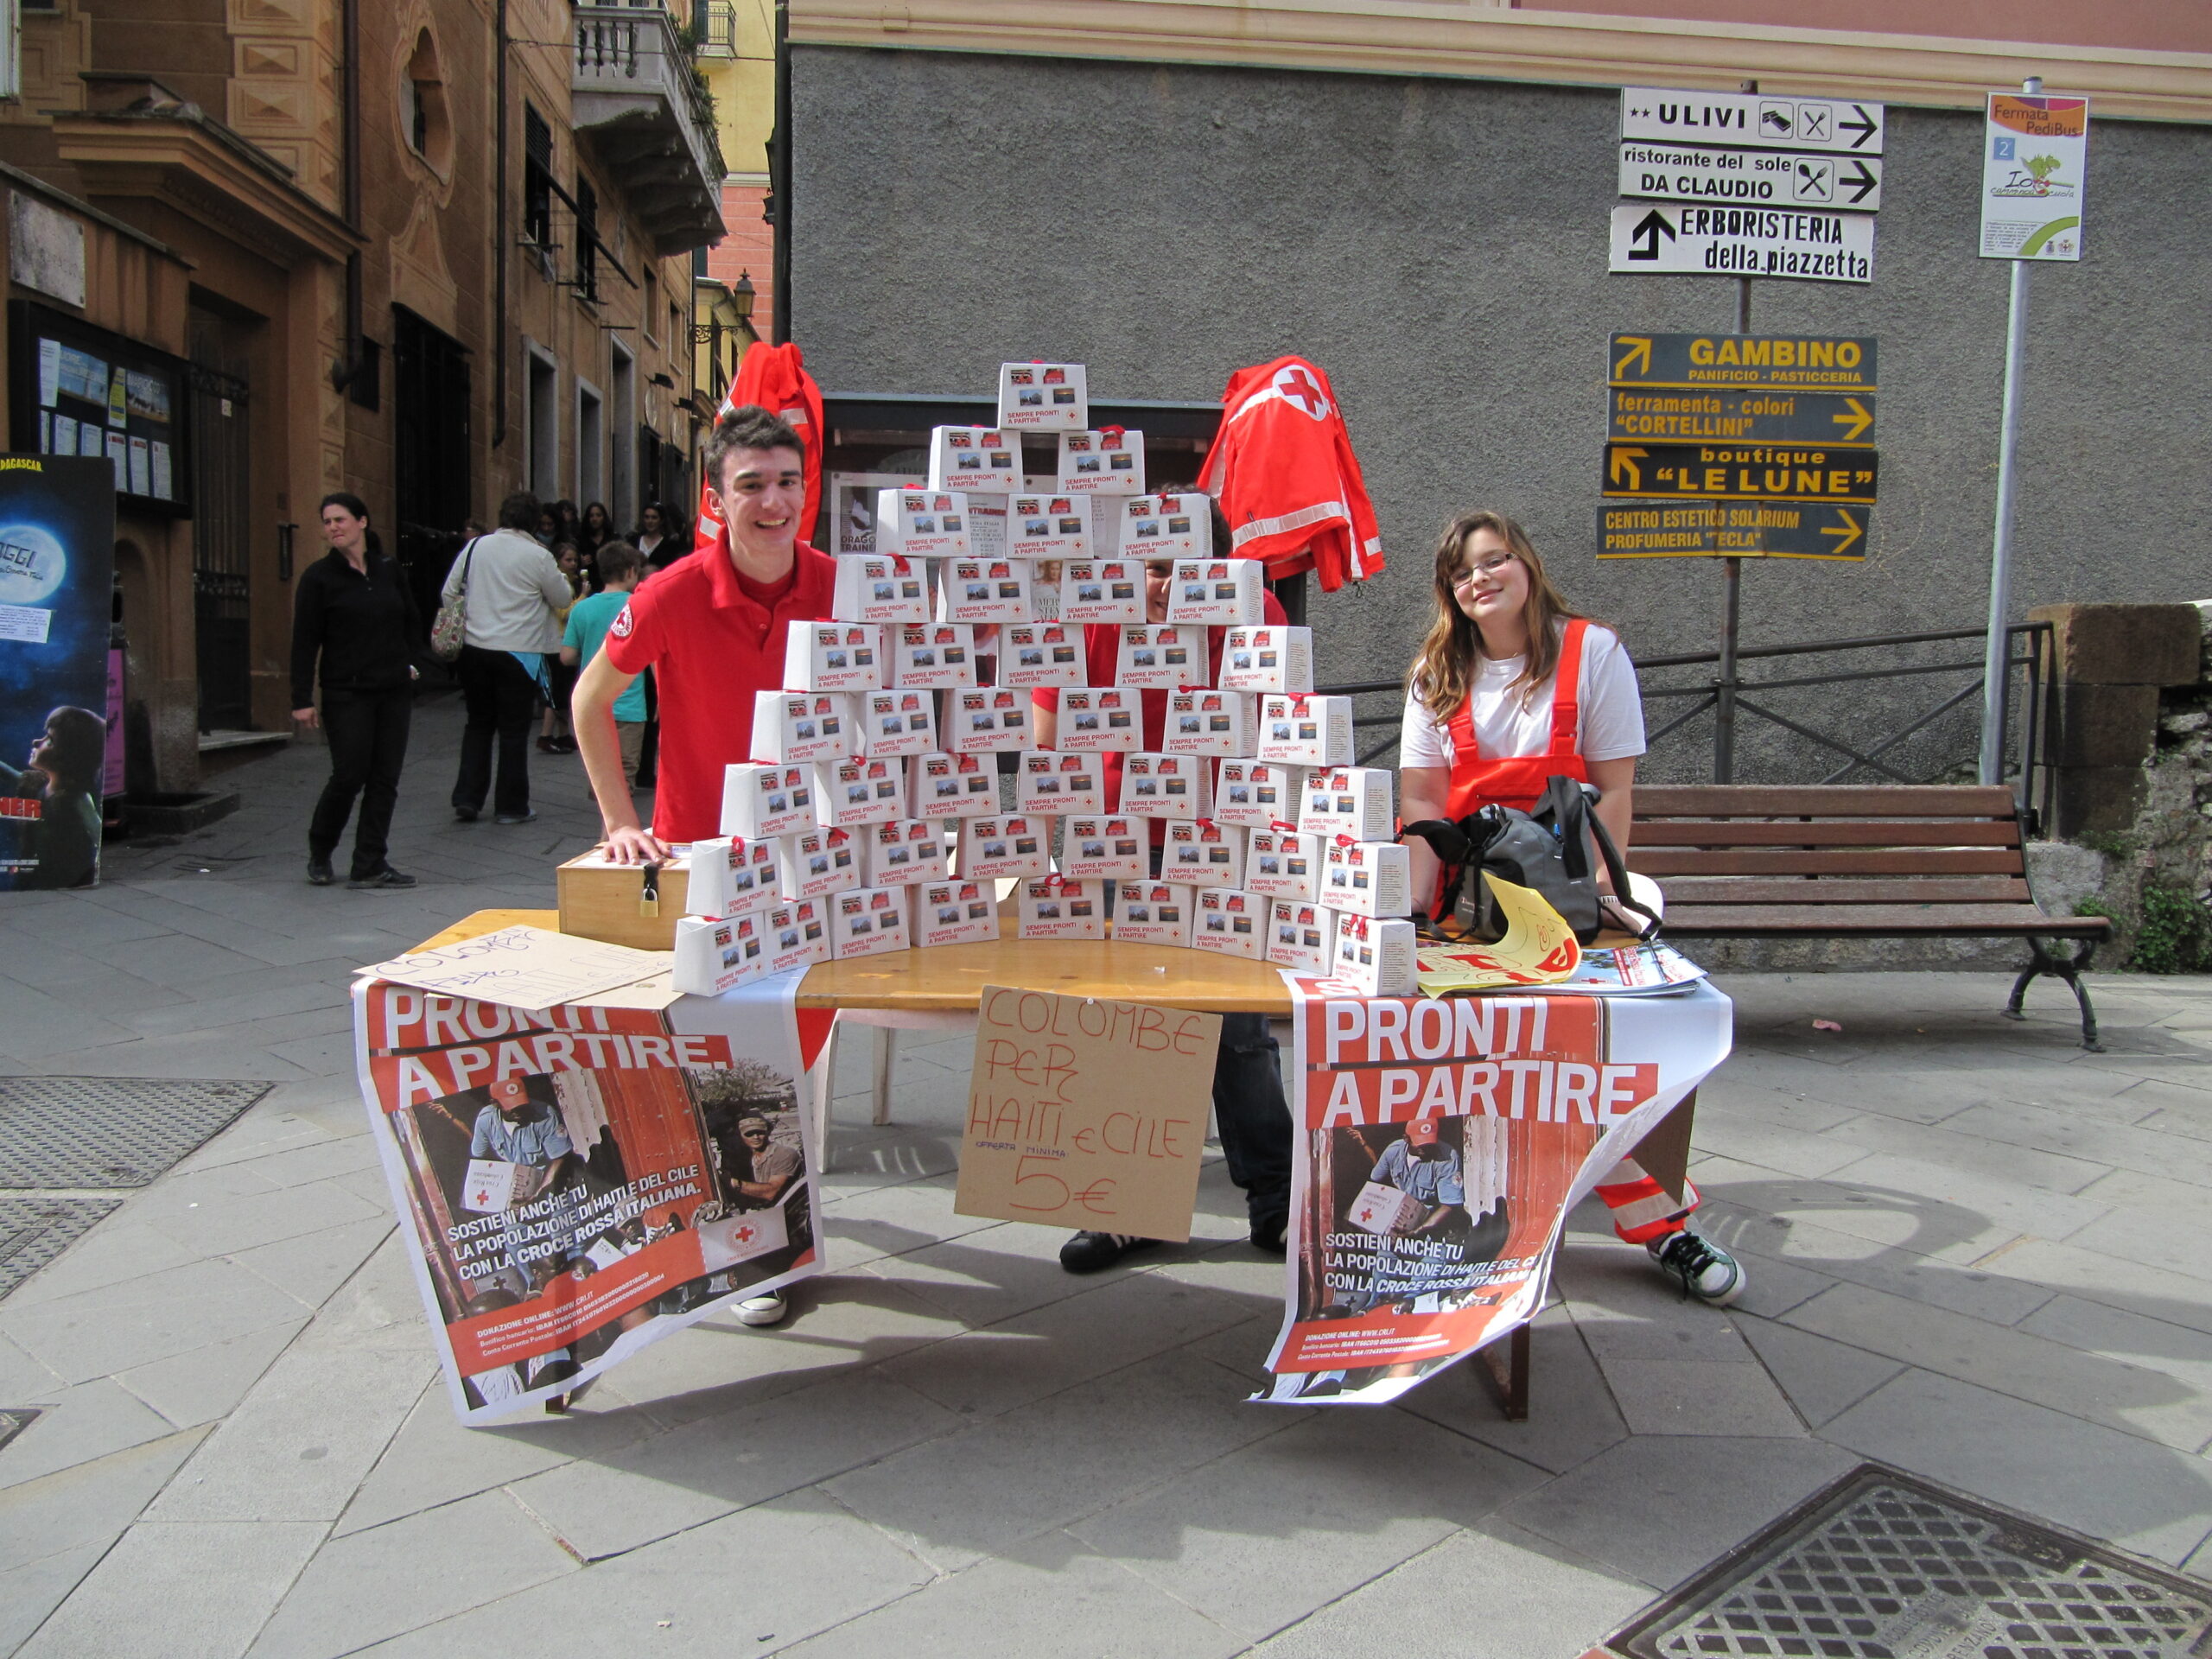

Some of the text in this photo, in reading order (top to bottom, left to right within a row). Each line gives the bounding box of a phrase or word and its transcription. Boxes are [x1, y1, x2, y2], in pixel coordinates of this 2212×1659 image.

[1659, 104, 1745, 128] ULIVI
[1994, 105, 2049, 120] Fermata
[2026, 121, 2077, 137] PediBus
[1624, 149, 1791, 172] ristorante del sole
[1999, 141, 2010, 156] 2
[1641, 174, 1773, 199] DA CLAUDIO
[1681, 208, 1842, 245] ERBORISTERIA
[1705, 240, 1868, 279] della piazzetta
[1689, 339, 1861, 368] GAMBINO
[1688, 371, 1759, 381] PANIFICIO
[1771, 371, 1862, 383] PASTICCERIA
[1617, 392, 1721, 413] ferramenta
[1741, 397, 1794, 416] colori
[1616, 416, 1753, 436] “CORTELLINI”
[1700, 448, 1826, 466] boutique
[1605, 510, 1800, 530] CENTRO ESTETICO SOLARIUM
[1605, 532, 1701, 550] PROFUMERIA
[839, 804, 883, 817] SEMPRE PRONTI
[845, 813, 868, 823] PARTIRE
[988, 989, 1205, 1055] COLOMBE
[1325, 997, 1548, 1063] PRONTI
[398, 1033, 728, 1109] A PARTIRE.
[985, 1039, 1078, 1103] PER
[1321, 1060, 1637, 1128] A PARTIRE
[969, 1092, 1064, 1146] HAITI
[1103, 1111, 1191, 1158] CILE
[448, 1185, 588, 1242] SOSTIENI ANCHE TU
[453, 1164, 699, 1262] LA POPOLAZIONE DI HAITI E DEL CILE
[459, 1181, 702, 1281] CON LA CROCE ROSSA ITALIANA.
[1325, 1233, 1464, 1261] SOSTIENI ANCHE TU
[1325, 1252, 1344, 1268] LA
[1346, 1254, 1440, 1277] POPOLAZIONE
[1440, 1265, 1457, 1276] DI
[1457, 1262, 1489, 1274] HAITI
[1487, 1261, 1498, 1271] E
[1497, 1258, 1521, 1270] DEL
[1325, 1273, 1356, 1290] CON
[1357, 1275, 1375, 1292] LA
[1376, 1278, 1425, 1293] CROCE
[1425, 1277, 1470, 1291] ROSSA
[477, 1319, 523, 1338] DONAZIONE
[524, 1310, 555, 1325] ONLINE:
